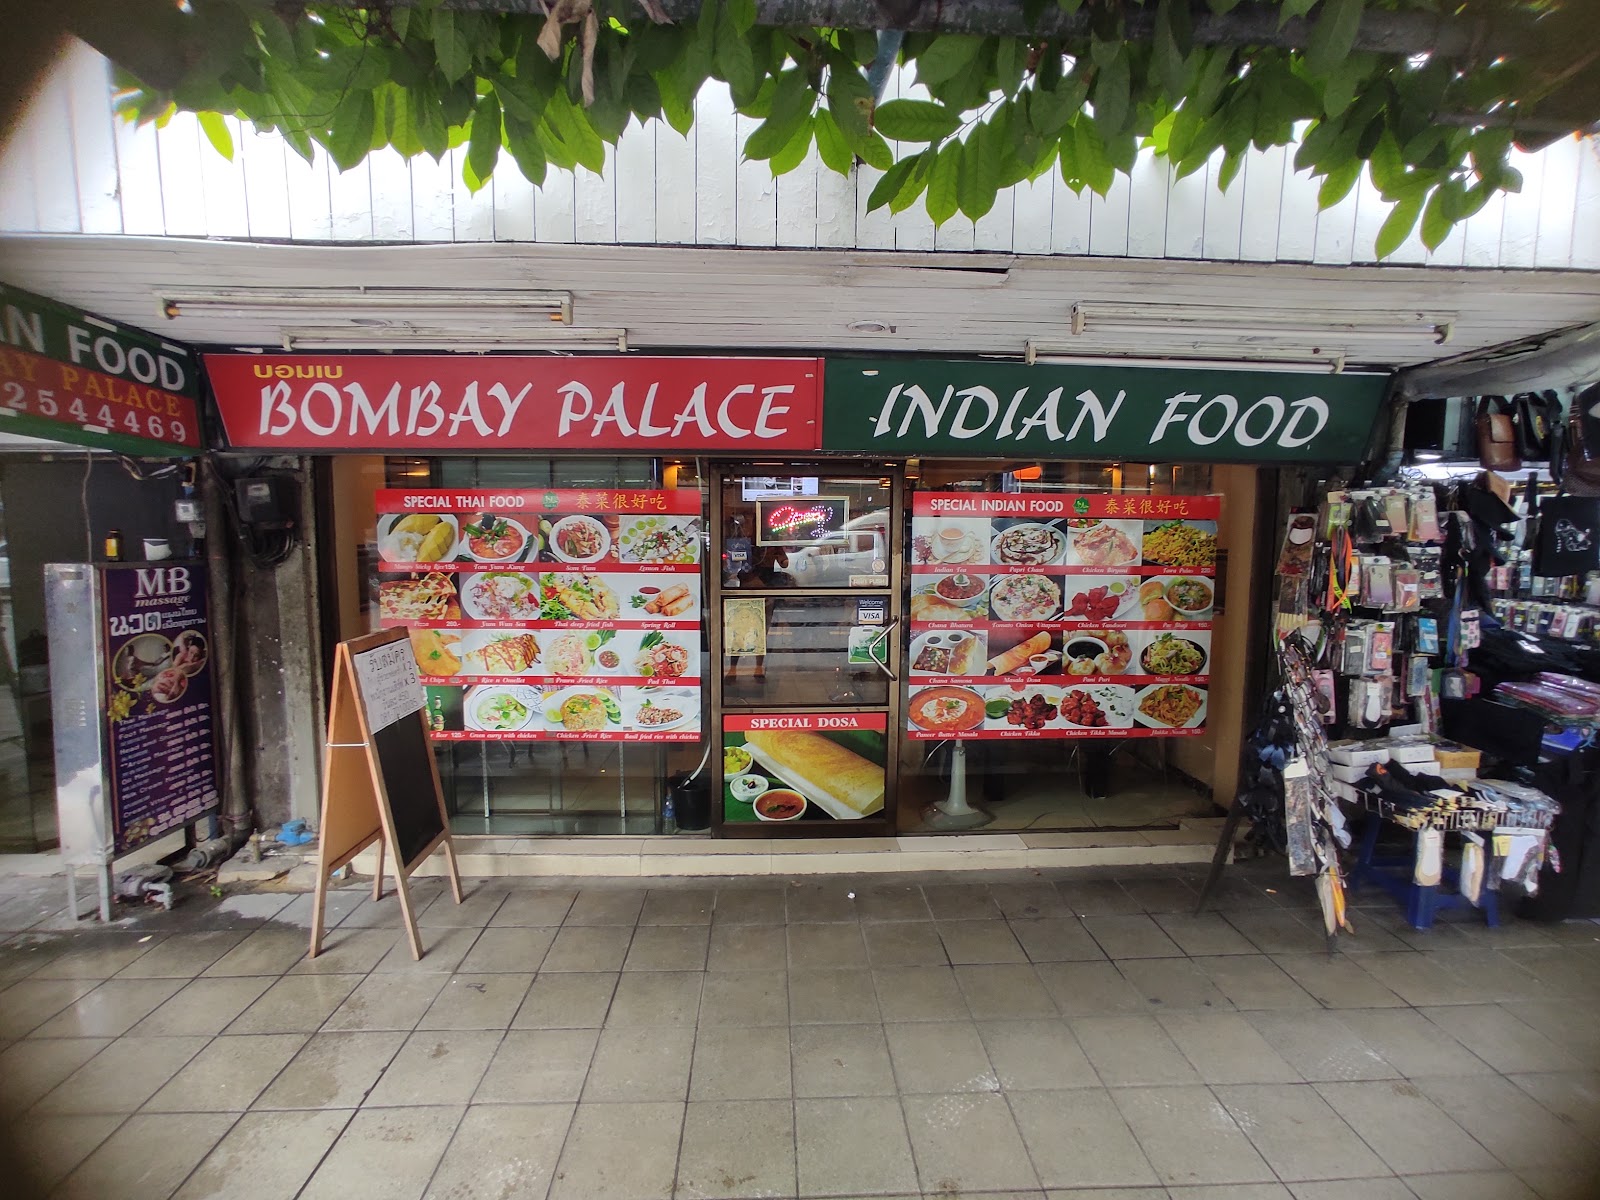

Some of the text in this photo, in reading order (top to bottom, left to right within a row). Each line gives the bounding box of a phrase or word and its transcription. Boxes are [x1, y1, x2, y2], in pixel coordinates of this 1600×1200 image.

[0, 304, 185, 391] N FOOD
[60, 365, 182, 417] PALACE
[258, 380, 796, 438] BOMBAY PALACE
[873, 383, 1330, 448] INDIAN FOOD
[403, 495, 525, 508] SPECIAL THAI FOOD
[575, 491, 667, 511] 泰菜很好吃
[930, 498, 1064, 513] SPECIAL INDIAN FOOD
[1104, 497, 1189, 516] 泰菜很好吃
[415, 563, 432, 572] Sticky
[489, 564, 504, 572] Yum
[506, 564, 525, 572] Kung
[1009, 566, 1026, 574] Papri
[1106, 567, 1128, 575] Biryani
[135, 566, 192, 598] MB
[135, 595, 192, 607] massage
[109, 611, 161, 637] นวด
[480, 621, 496, 629] Yum
[585, 621, 600, 629] fried
[601, 621, 614, 629] fish
[595, 677, 608, 685] Rice
[750, 717, 859, 729] SPECIAL DOSA
[638, 733, 652, 741] fried
